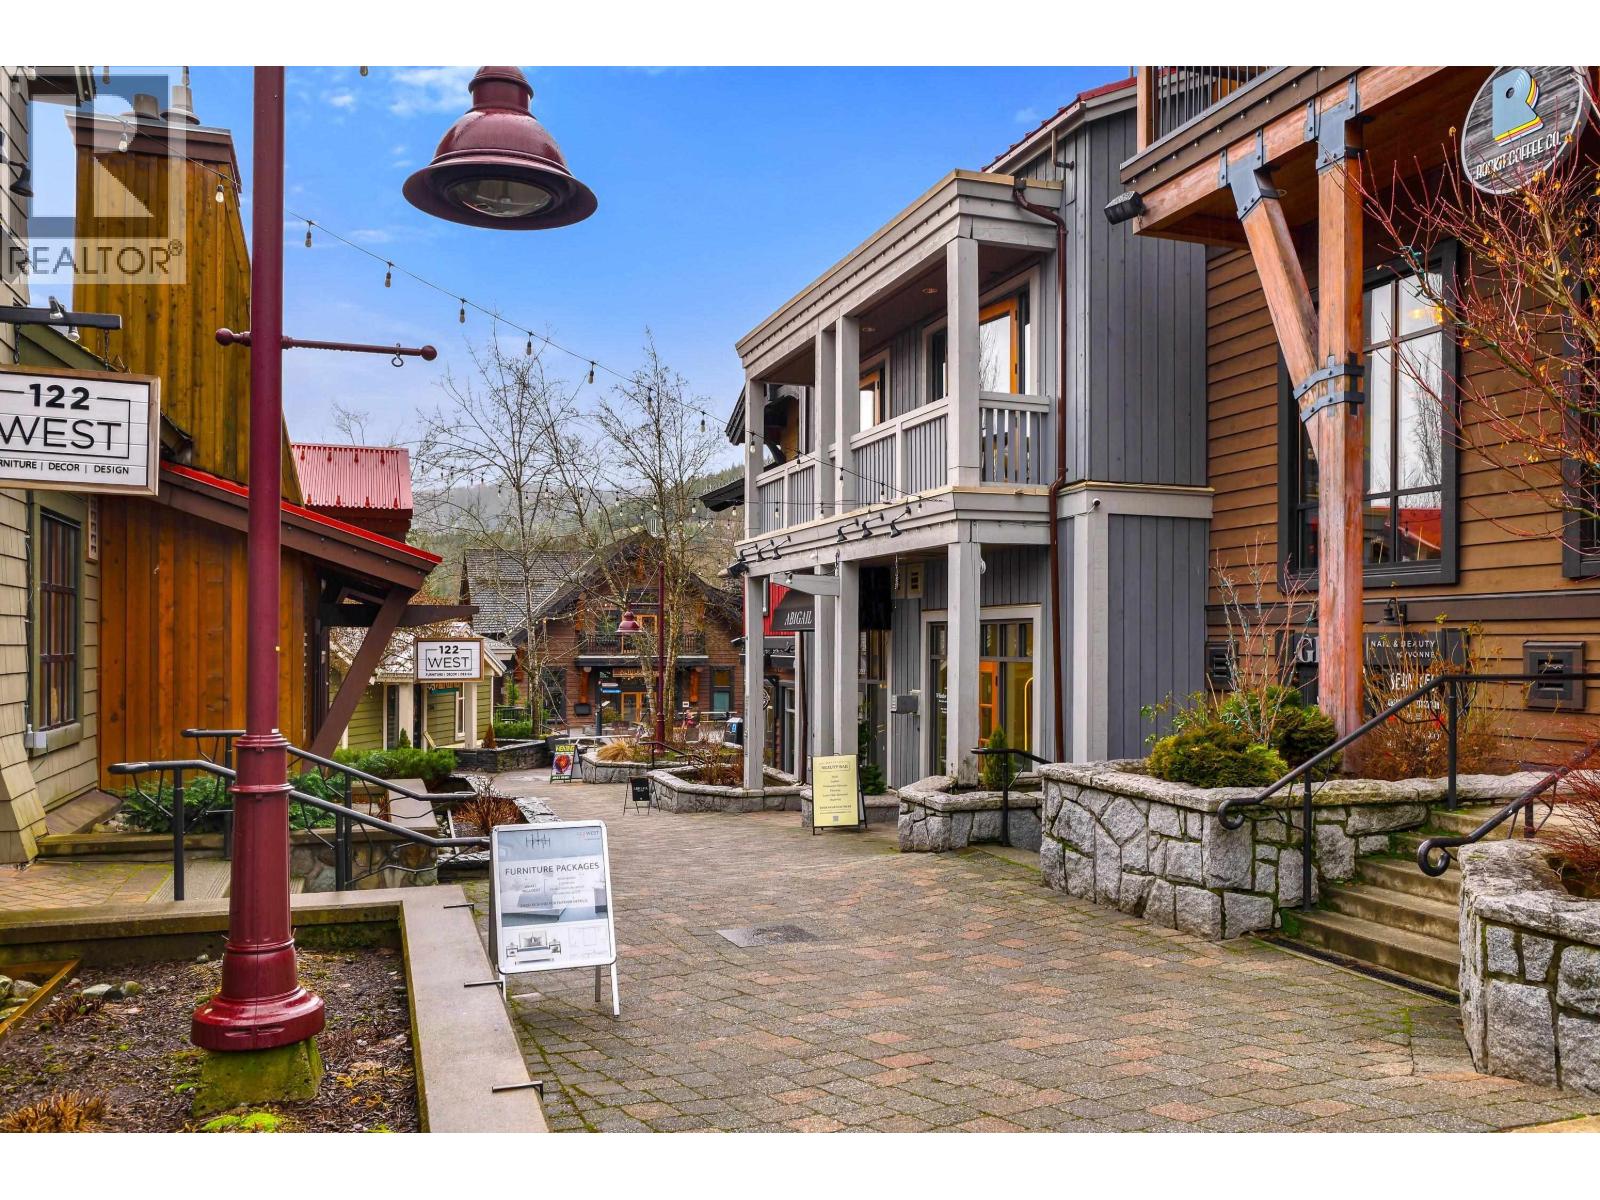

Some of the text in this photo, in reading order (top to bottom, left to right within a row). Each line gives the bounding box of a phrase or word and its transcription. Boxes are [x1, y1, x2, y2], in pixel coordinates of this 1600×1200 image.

[1508, 137, 1544, 166] COFFEE
[29, 383, 90, 410] 122
[0, 416, 122, 451] WEST
[48, 462, 80, 472] DECOR
[94, 465, 129, 474] DESIGN
[784, 610, 813, 626] ABIGAIL
[439, 645, 459, 654] 122
[1393, 639, 1399, 648] &
[1400, 640, 1436, 648] BEAUTY
[427, 656, 470, 668] WEST
[505, 862, 600, 876] FURNITURE PACKAGES
